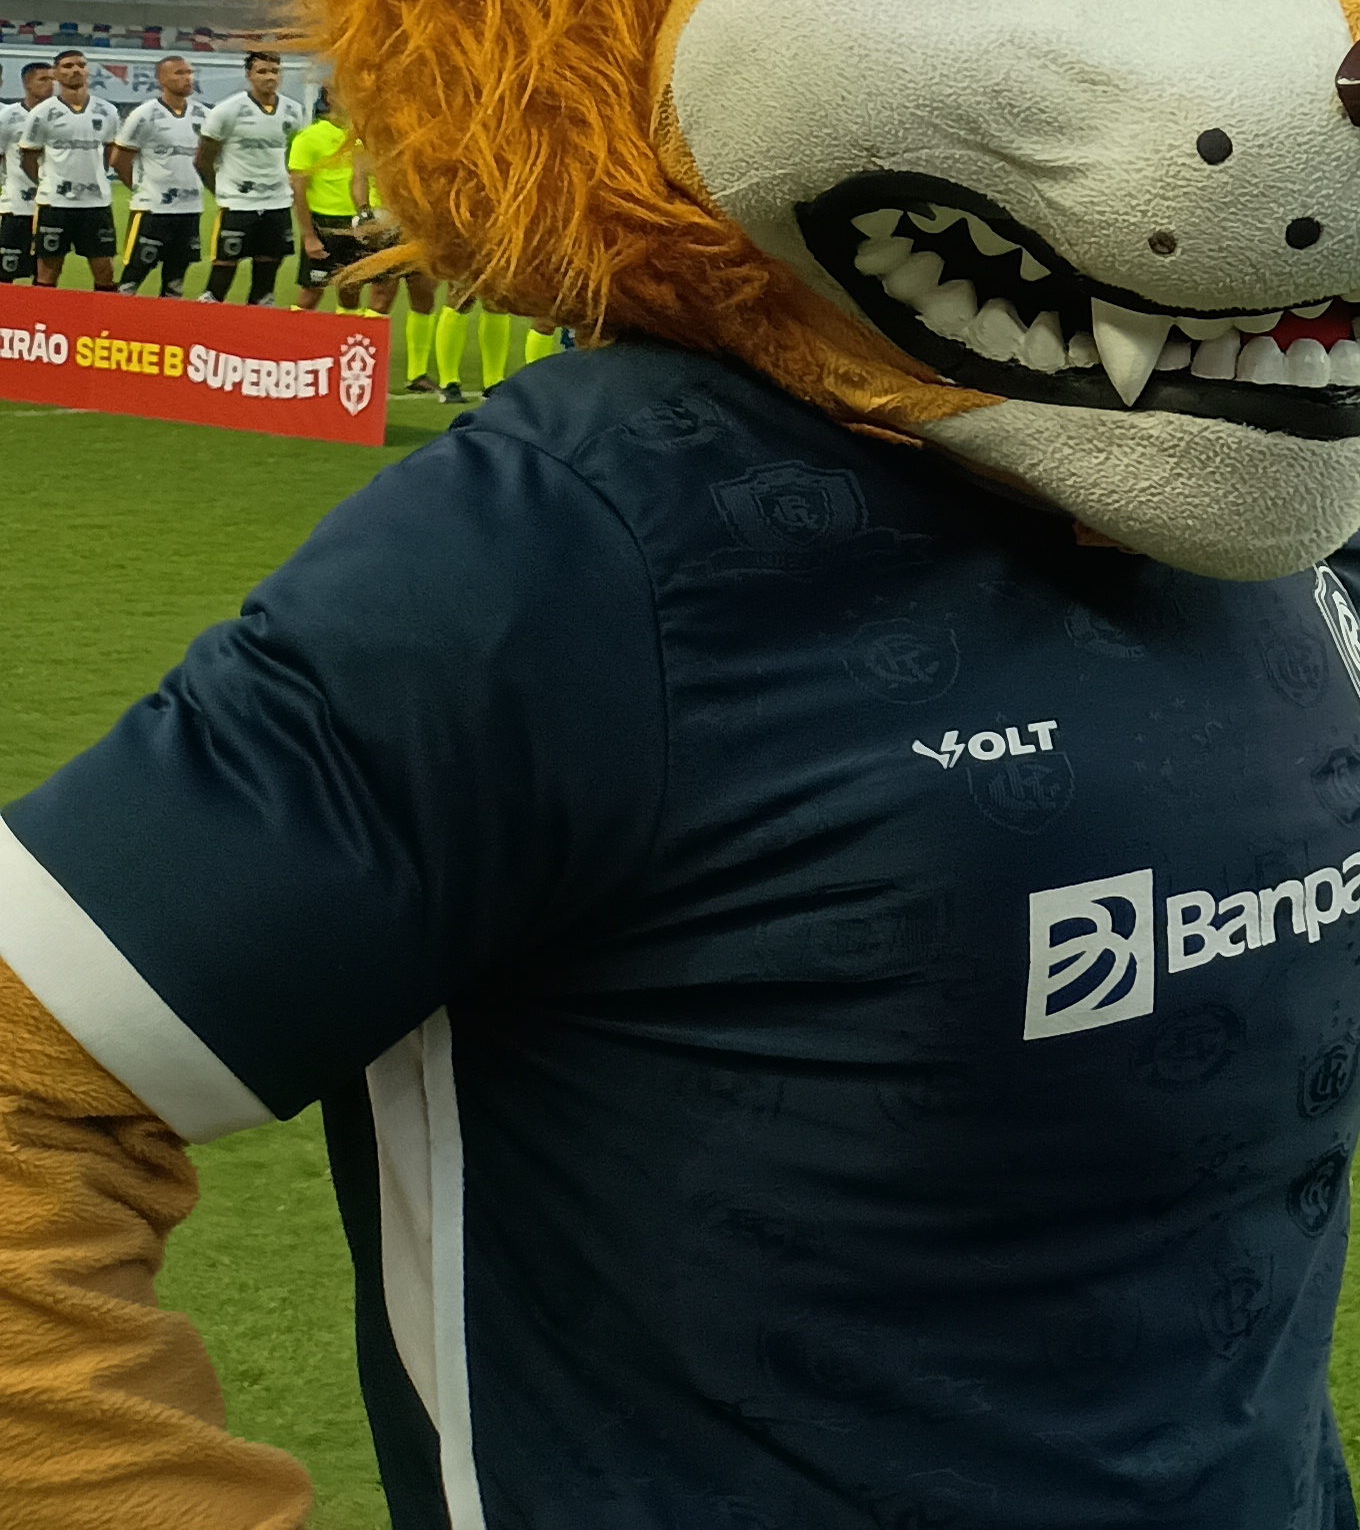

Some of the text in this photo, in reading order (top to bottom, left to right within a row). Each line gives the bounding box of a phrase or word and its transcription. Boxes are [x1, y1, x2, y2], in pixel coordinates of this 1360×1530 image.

[0, 323, 335, 399] IRÃO SÉRIE B SUPERBET
[911, 719, 1058, 770] VOLT
